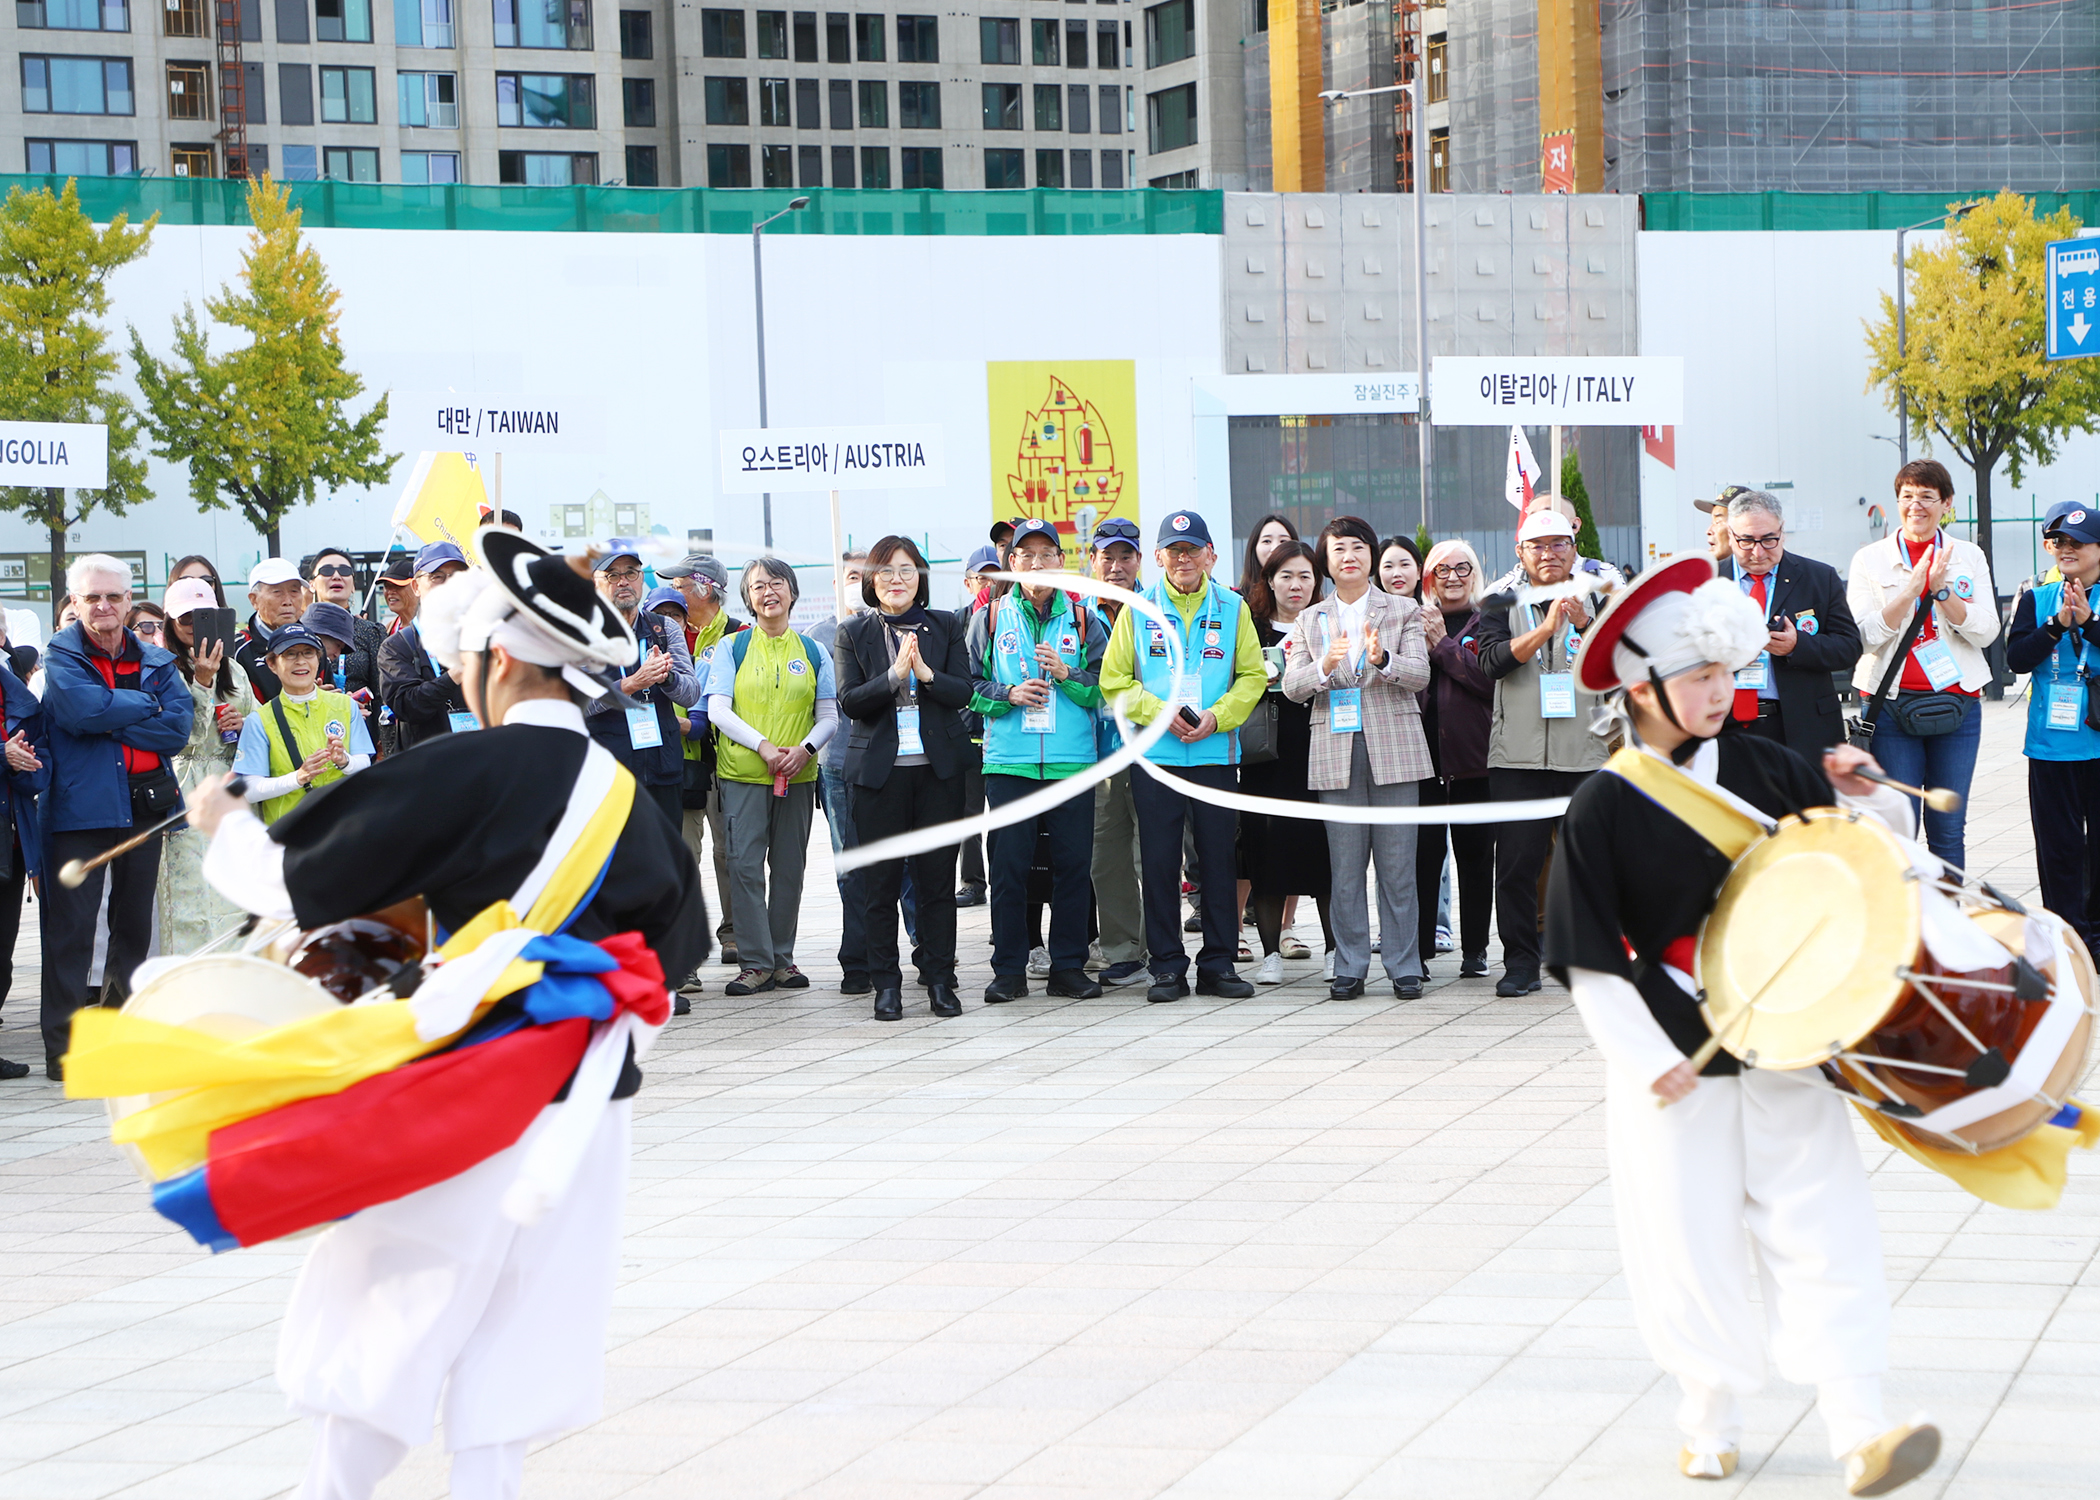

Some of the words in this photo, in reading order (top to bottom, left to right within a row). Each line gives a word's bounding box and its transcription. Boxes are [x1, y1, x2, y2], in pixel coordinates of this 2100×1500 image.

[174, 81, 180, 92] 7
[179, 165, 185, 175] 6
[1354, 383, 1410, 401] 잠실진주
[1480, 374, 1558, 405] 이탈리아
[1577, 376, 1635, 403] ITALY
[437, 407, 471, 436] 대만
[487, 410, 559, 434] TAIWAN
[0, 439, 69, 466] GOLIA
[741, 443, 829, 473] 오스트리아
[844, 442, 926, 469] AUSTRIA
[45, 532, 81, 543] 도관
[433, 517, 465, 553] Chinese
